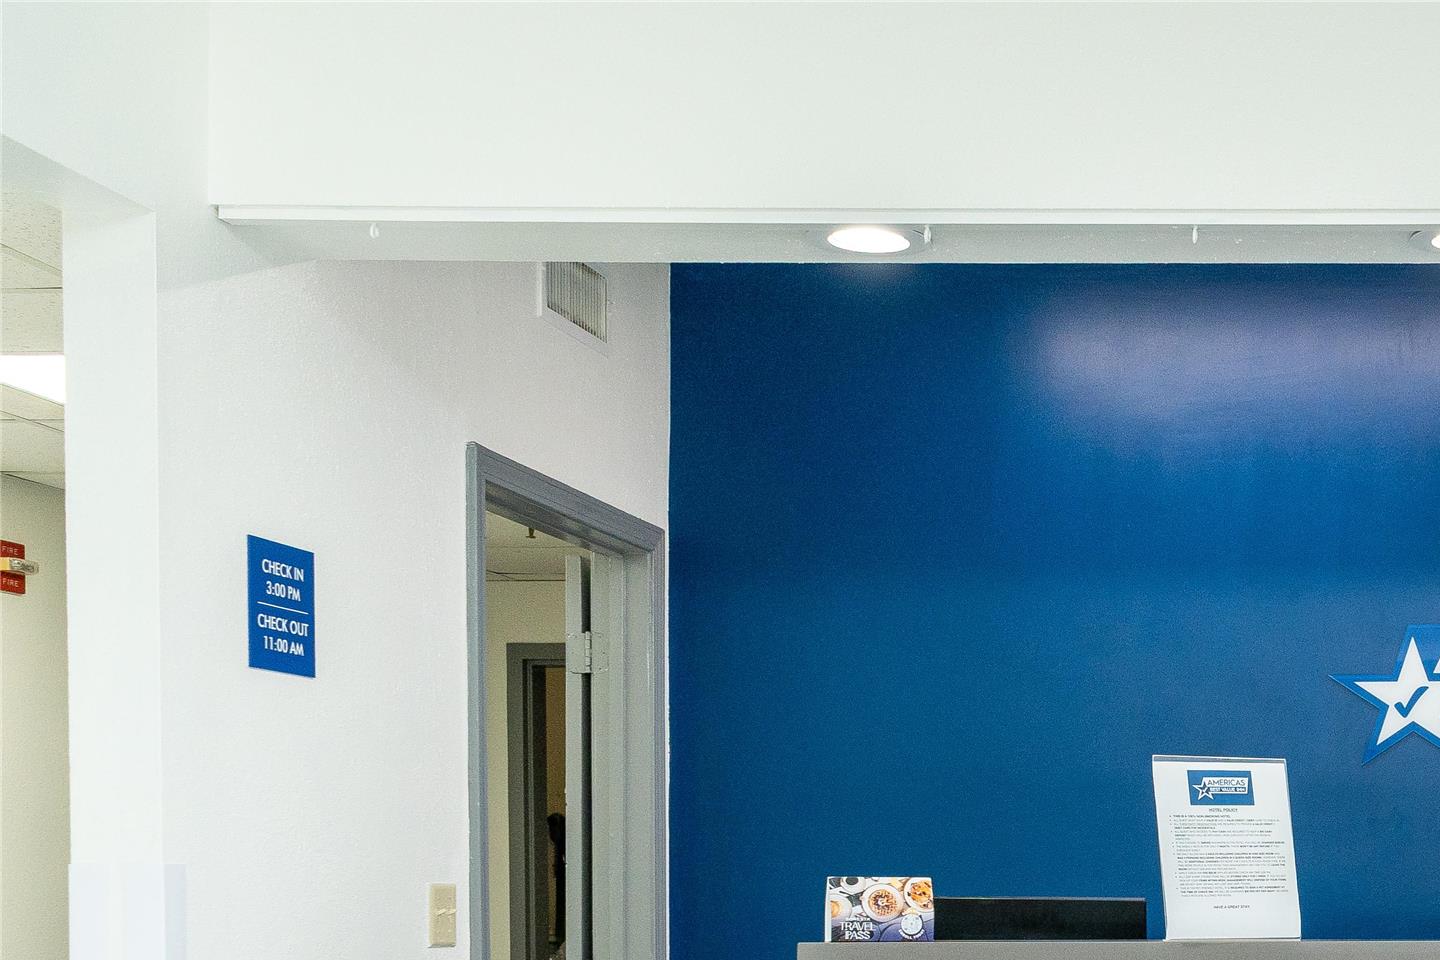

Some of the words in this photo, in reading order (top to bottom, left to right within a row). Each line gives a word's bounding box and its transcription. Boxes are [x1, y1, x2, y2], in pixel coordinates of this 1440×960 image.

[1, 545, 19, 556] FIRE
[261, 558, 293, 580] CHECK
[293, 567, 305, 583] IN
[2, 577, 20, 588] FIRE
[265, 580, 286, 598] 3:00
[287, 586, 301, 602] PM
[257, 613, 289, 633] CHECK
[289, 620, 309, 637] OUT
[263, 635, 289, 654] 11:00
[289, 641, 305, 657] AM
[1207, 778, 1246, 787] AMERICAS
[838, 921, 877, 931] TRAVEL
[844, 930, 871, 940] PASS
